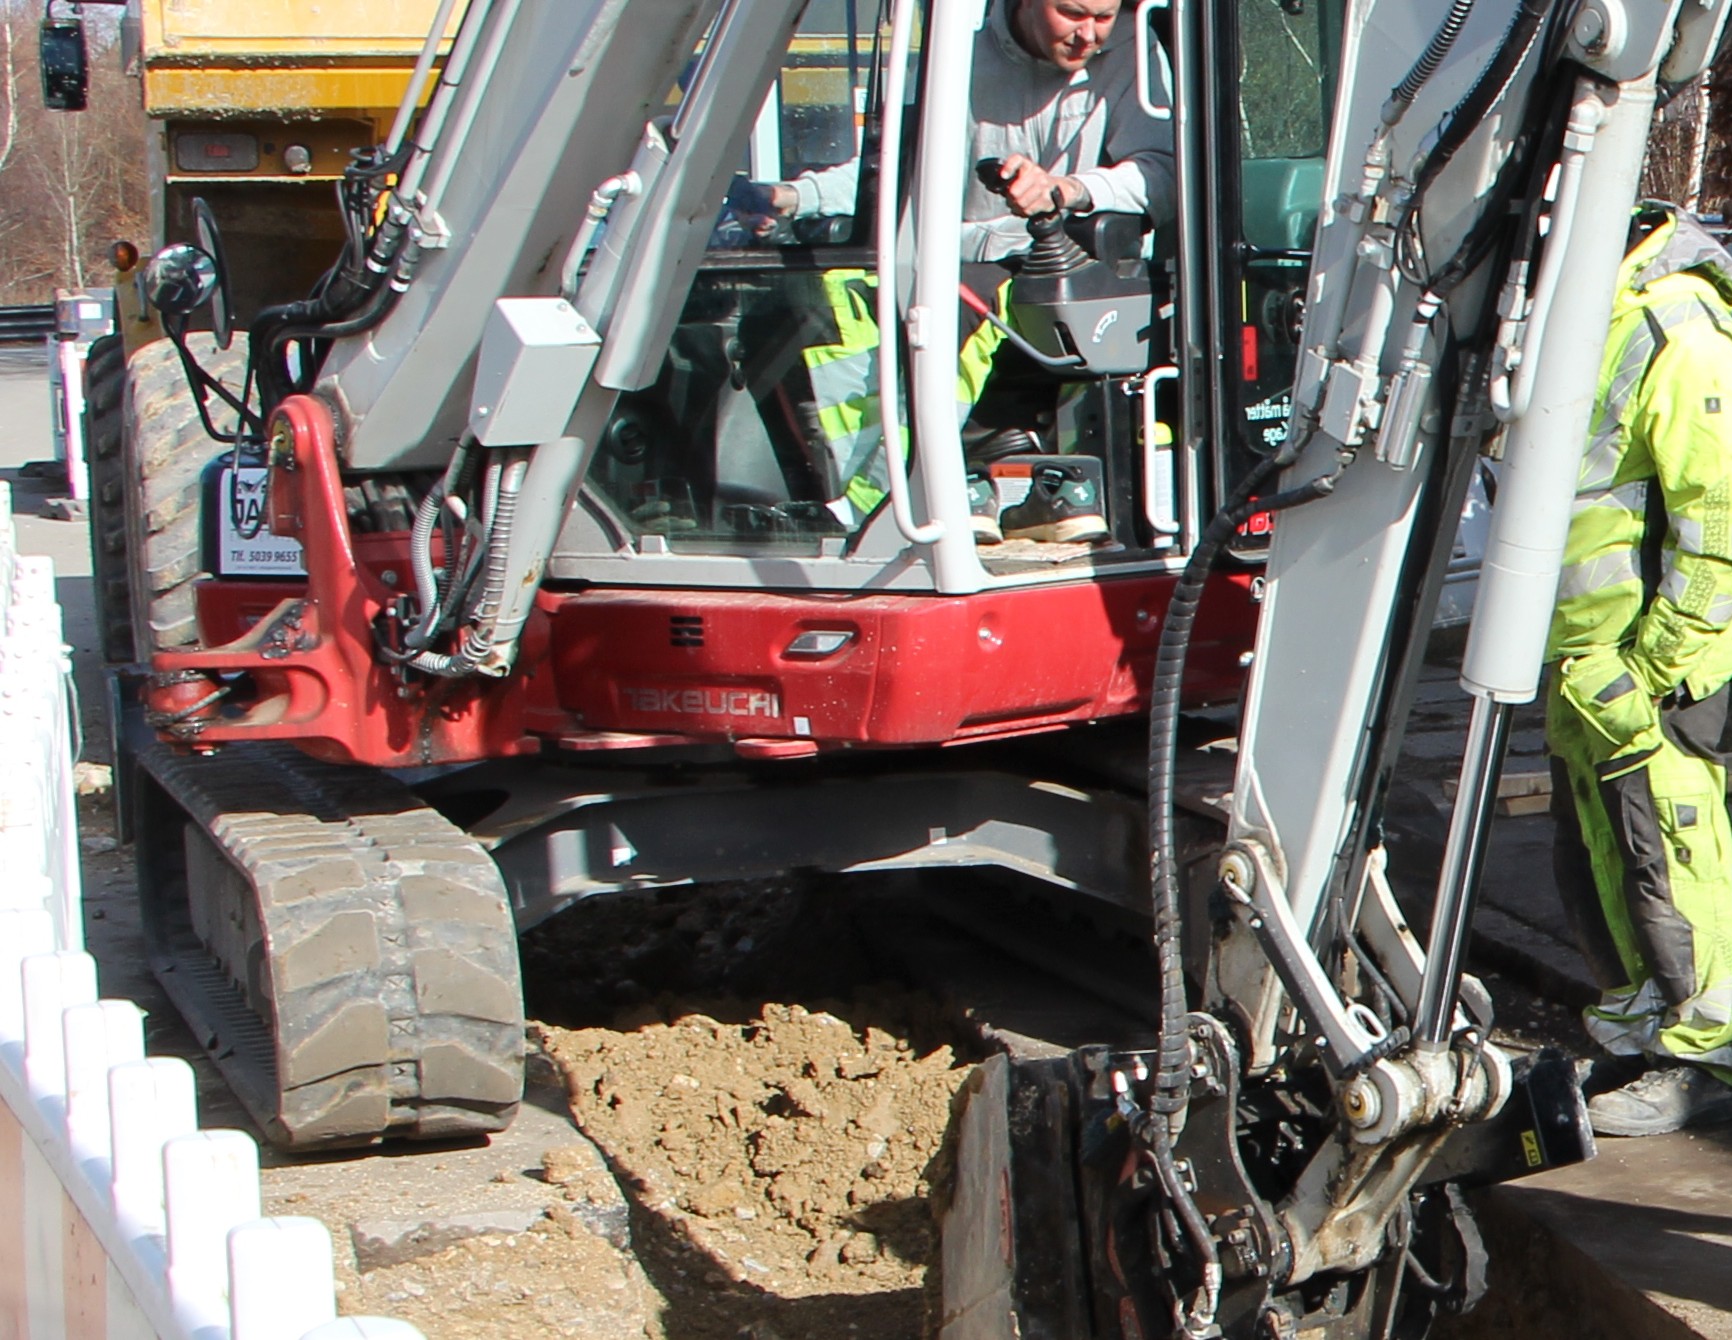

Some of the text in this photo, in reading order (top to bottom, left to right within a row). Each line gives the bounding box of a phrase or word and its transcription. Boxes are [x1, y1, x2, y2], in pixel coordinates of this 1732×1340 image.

[249, 550, 271, 562] 5039
[274, 551, 297, 562] 9655
[623, 687, 779, 718] TAKEUCHI
